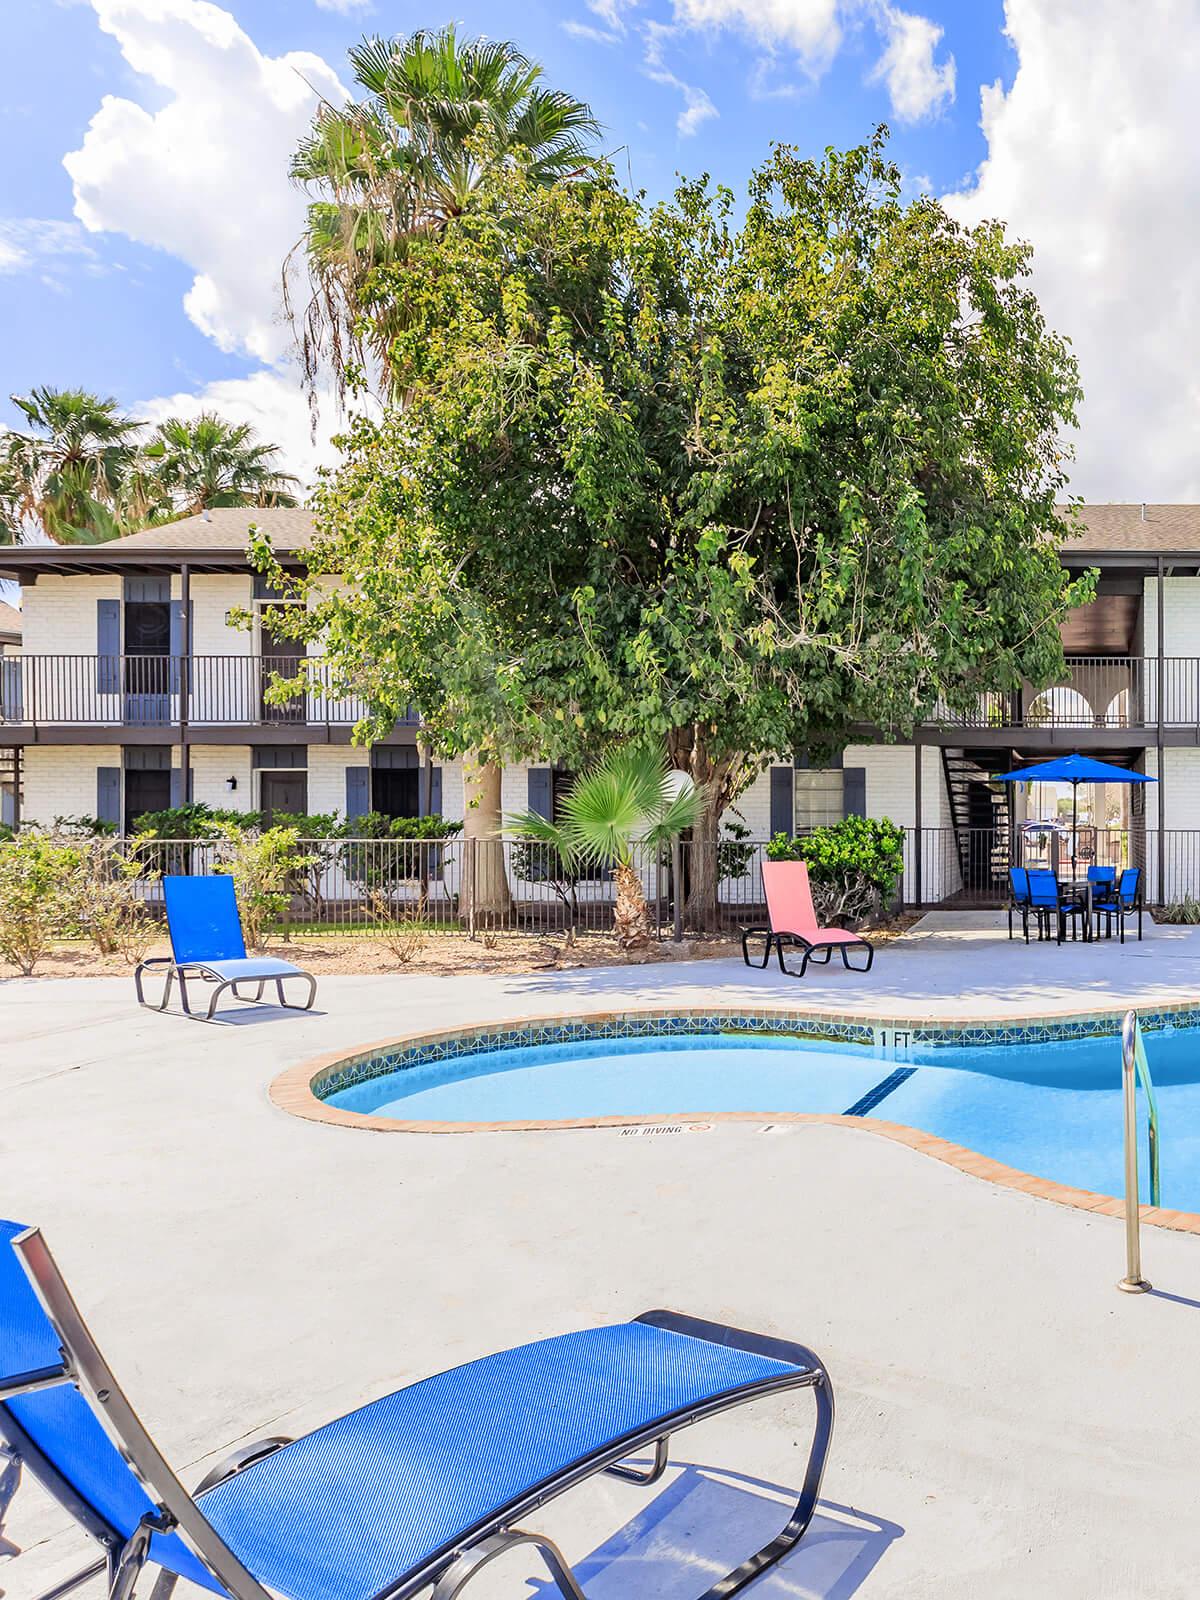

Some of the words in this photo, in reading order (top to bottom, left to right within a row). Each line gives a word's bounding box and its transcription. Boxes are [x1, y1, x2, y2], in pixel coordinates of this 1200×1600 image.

[880, 1031, 887, 1047] 1
[894, 1031, 911, 1048] FT
[621, 1128, 639, 1137] NO
[642, 1126, 682, 1136] DIVING
